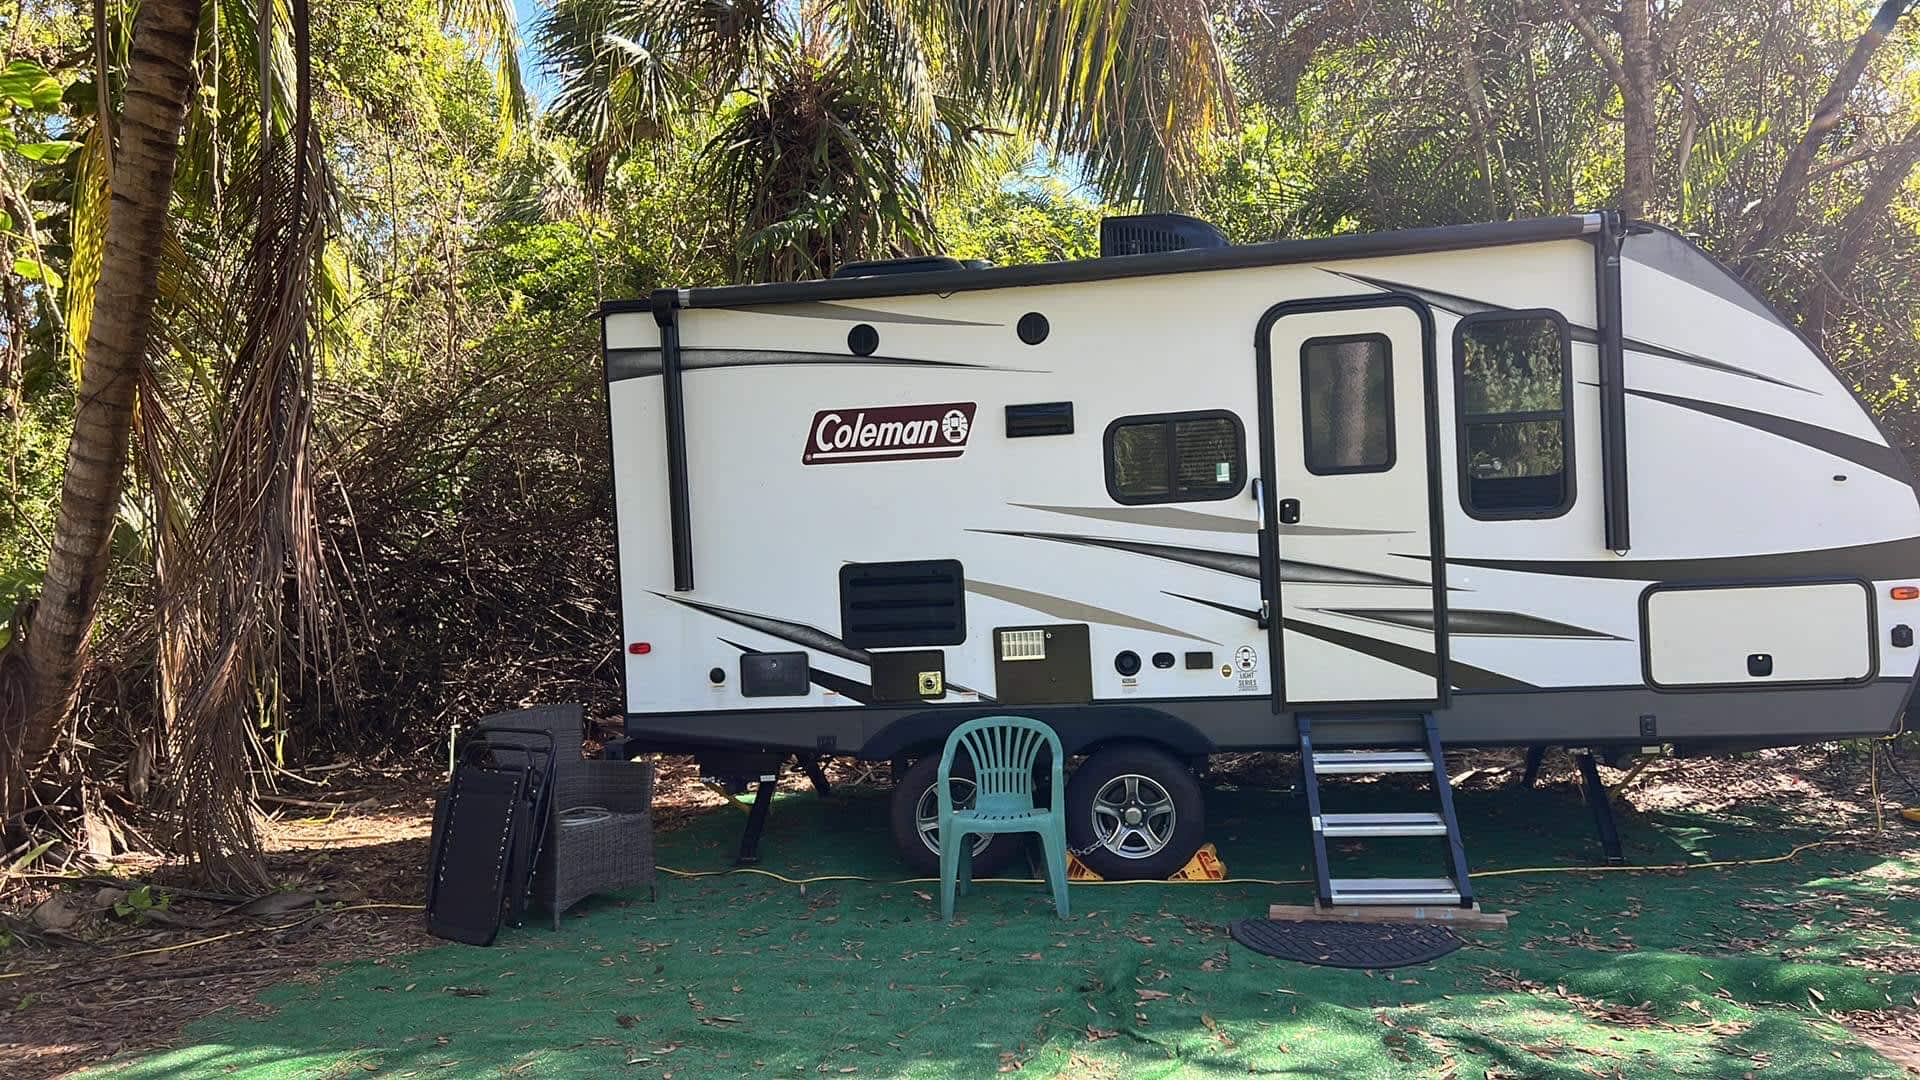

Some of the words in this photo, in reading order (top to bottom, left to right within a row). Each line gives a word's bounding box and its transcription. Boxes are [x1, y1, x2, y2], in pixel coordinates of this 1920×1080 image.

[815, 413, 939, 452] Coleman
[1239, 672, 1254, 680] LIGHT
[1238, 679, 1257, 687] SERIES
